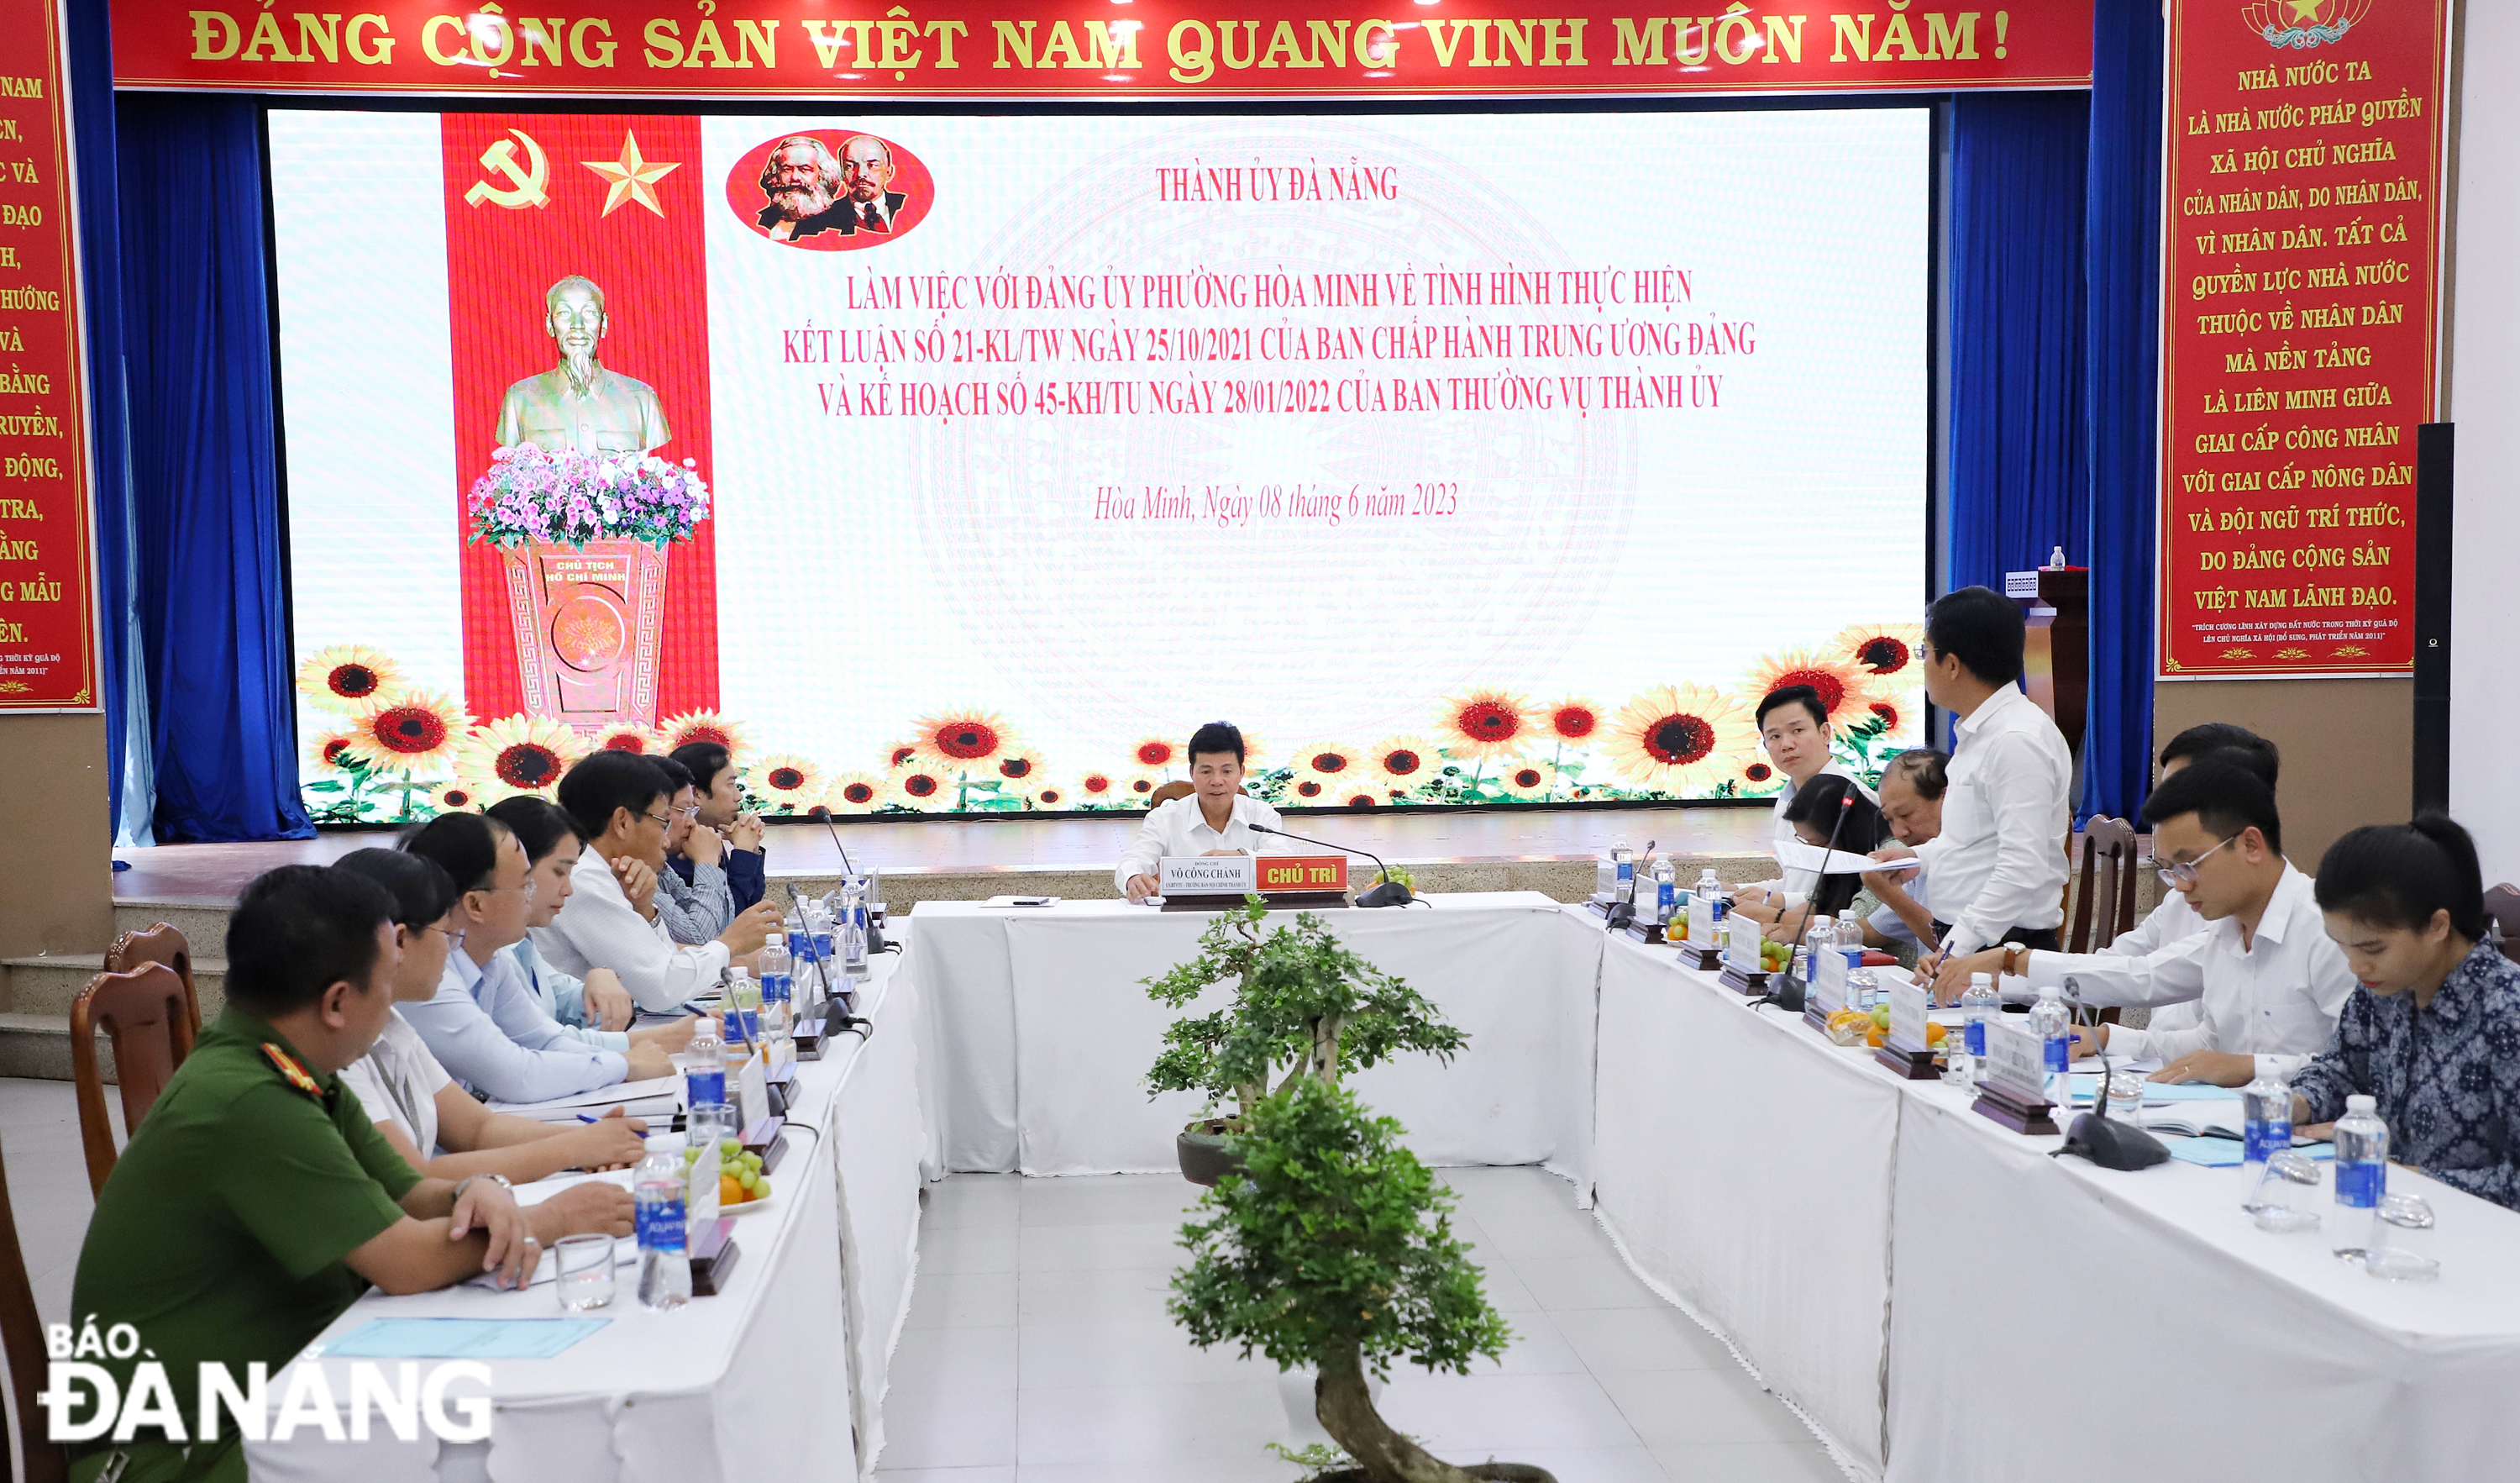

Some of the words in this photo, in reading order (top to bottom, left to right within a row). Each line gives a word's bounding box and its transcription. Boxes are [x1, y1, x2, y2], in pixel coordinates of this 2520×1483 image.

[189, 0, 396, 65] ĐẢNG
[420, 2, 617, 78] CỘNG
[643, 0, 780, 68] SẢN
[801, 5, 969, 81] VIỆT
[992, 19, 1142, 68] NAM
[1167, 18, 1400, 83] QUANG
[1420, 18, 1588, 66] VINH
[1613, 1, 1808, 65] MUÔN
[0, 76, 43, 98] NAM
[2238, 64, 2279, 90] NHÀ
[2286, 60, 2339, 87] NƯỚC
[2345, 61, 2371, 81] TA
[2188, 110, 2210, 134] LÀ
[2216, 107, 2251, 133] NHÀ
[2257, 103, 2303, 129] NƯỚC
[2309, 98, 2356, 125] PHÁP
[2362, 87, 2422, 127] QUYỀN
[11, 158, 39, 183] VÀ
[2210, 149, 2238, 173] XÃ
[2244, 145, 2278, 175] HỘI
[2286, 139, 2326, 168] CHỦ
[2333, 138, 2396, 164] NGHĨA
[1156, 158, 1242, 201] THÀNH
[1250, 157, 1282, 201] ỦY
[1289, 158, 1322, 200] ĐÀ
[1329, 156, 1397, 200] NẴNG
[2184, 189, 2215, 216] CỦA
[2219, 187, 2262, 213] NHÂN
[2267, 185, 2302, 210] DÂN,
[2309, 187, 2330, 207] DO
[2335, 179, 2380, 205] NHÂN
[2384, 176, 2422, 202] DÂN,
[3, 205, 41, 229] ĐẠO
[2196, 230, 2215, 255] VÌ
[2222, 227, 2276, 253] NHÂN
[2281, 224, 2327, 249] DÂN.
[2334, 216, 2374, 245] TẤT
[2381, 215, 2407, 243] CẢ
[848, 266, 901, 308] LÀM
[909, 271, 967, 318] VIỆC
[974, 266, 1018, 309] VỚI
[1026, 266, 1095, 308] ĐẢNG
[1104, 265, 1135, 308] ỦY
[1142, 265, 1247, 308] PHƯỜNG
[1254, 265, 1306, 307] HÒA
[1314, 274, 1378, 307] MINH
[1385, 263, 1415, 306] VỀ
[1424, 263, 1482, 305] TÌNH
[1490, 262, 1551, 304] HÌNH
[1557, 266, 1625, 313] THỰC
[1635, 265, 1692, 312] HIỆN
[2192, 263, 2257, 300] QUYỀN
[2263, 267, 2301, 294] LỰC
[2307, 261, 2349, 287] NHÀ
[2355, 259, 2409, 285] NƯỚC
[0, 285, 59, 311] HƯỚNG
[2197, 308, 2261, 336] THUỘC
[2268, 300, 2293, 330] VỀ
[2301, 302, 2355, 329] NHÂN
[2362, 300, 2403, 325] DÂN
[0, 326, 24, 351] VÀ
[784, 319, 832, 362] KẾT
[840, 324, 906, 372] LUẬN
[915, 319, 944, 362] SỐ
[953, 329, 1063, 362] 21-KL/TW
[1071, 318, 1139, 361] NGÀY
[1147, 328, 1251, 360] 25/10/2021
[1261, 317, 1310, 360] CỦA
[1316, 327, 1363, 360] BAN
[1373, 316, 1436, 359] CHẤP
[1444, 316, 1512, 358] HÀNH
[1520, 323, 1602, 357] TRUNG
[1610, 318, 1680, 356] ƯƠNG
[1688, 313, 1755, 355] ĐẢNG
[2226, 348, 2257, 372] MÀ
[2265, 340, 2307, 371] NỀN
[2313, 341, 2371, 367] TẢNG
[0, 363, 50, 394] BẰNG
[818, 373, 852, 415] VÀ
[859, 373, 892, 415] KẾ
[900, 382, 989, 424] HOẠCH
[997, 371, 1026, 415] SỐ
[1035, 381, 1141, 414] 45-KH/TU
[1149, 371, 1217, 413] NGÀY
[1224, 380, 1329, 413] 28/01/2022
[1337, 369, 1387, 412] CỦA
[1393, 379, 1441, 411] BAN
[1448, 368, 1552, 410] THƯỜNG
[1559, 376, 1591, 418] VỤ
[1599, 366, 1683, 408] THÀNH
[1692, 365, 1722, 408] ỦY
[2204, 389, 2229, 413] LÀ
[2234, 387, 2279, 412] LIÊN
[2286, 389, 2337, 409] MINH
[2344, 382, 2391, 407] GIỮA
[0, 405, 63, 439] RUYỀN,
[2196, 434, 2235, 453] GIAI
[2242, 423, 2279, 451] CẤP
[2286, 425, 2339, 450] CÔNG
[2344, 421, 2399, 446] NHÂN
[5, 452, 63, 481] ĐỘNG,
[2182, 469, 2214, 492] VỚI
[2222, 472, 2260, 492] GIAI
[2268, 461, 2305, 489] CẤP
[2312, 464, 2365, 487] NÔNG
[2371, 461, 2412, 486] DÂN
[0, 499, 43, 521] TRA,
[1095, 486, 1135, 519] Hòa
[1143, 486, 1194, 521] Minh,
[1203, 486, 1252, 527] Ngày
[1260, 486, 1280, 516] 08
[1289, 484, 1341, 526] tháng
[1349, 484, 1358, 516] 6
[1366, 486, 1404, 516] năm
[1412, 483, 1457, 515] 2023
[2188, 507, 2214, 531] VÀ
[2220, 507, 2254, 534] ĐỘI
[2260, 505, 2299, 529] NGŨ
[2306, 503, 2339, 527] TRÍ
[2346, 502, 2405, 527] THỨC,
[2201, 552, 2226, 570] DO
[2233, 544, 2286, 569] ĐẢNG
[2292, 544, 2345, 571] CỘNG
[2352, 539, 2391, 565] SẢN
[20, 572, 60, 601] MẪU
[591, 573, 626, 581] MINH
[2194, 586, 2239, 613] VIỆT
[2245, 589, 2286, 607] NAM
[2293, 584, 2345, 607] LÃNH
[2351, 586, 2397, 609] ĐẠO.
[2264, 634, 2275, 642] HỘI
[2289, 619, 2302, 628] ĐẤT
[2389, 618, 2397, 628] ĐỘ
[50, 654, 60, 662] ĐỘ
[1170, 867, 1184, 879] VÕ
[1184, 866, 1210, 879] CÔNG
[1210, 866, 1241, 879] CHÁNH
[1267, 863, 1304, 884] CHỦ
[1309, 864, 1336, 883] TRÌ
